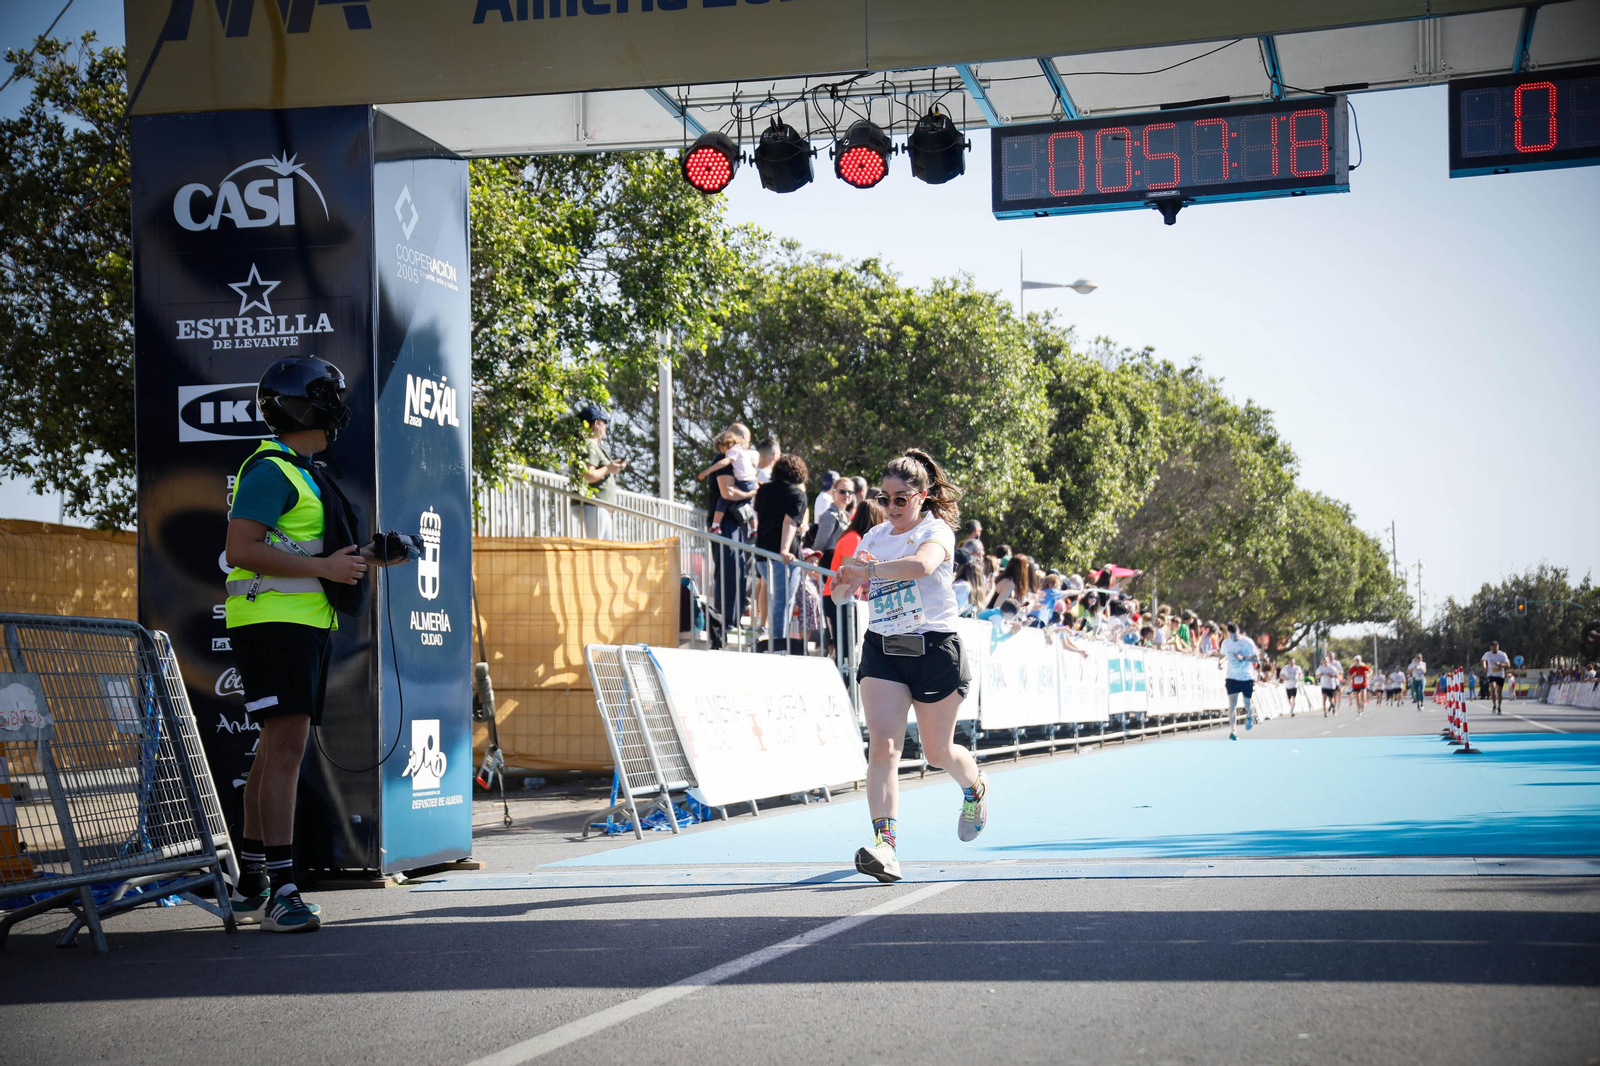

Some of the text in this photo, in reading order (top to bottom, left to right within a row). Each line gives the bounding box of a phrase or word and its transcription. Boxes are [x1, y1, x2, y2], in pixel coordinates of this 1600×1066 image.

[1049, 109, 1329, 197] 00:57:18
[173, 177, 296, 231] CASI
[396, 243, 457, 283] COOPERACIÓN
[396, 261, 419, 284] 2005
[176, 312, 334, 339] ESTRELLA
[212, 336, 298, 350] DE LEVANTE
[404, 373, 459, 428] NEXAL
[874, 587, 916, 614] 5414
[410, 608, 451, 632] ALMERÍA
[213, 640, 226, 649] La
[421, 632, 443, 646] CIUDAD
